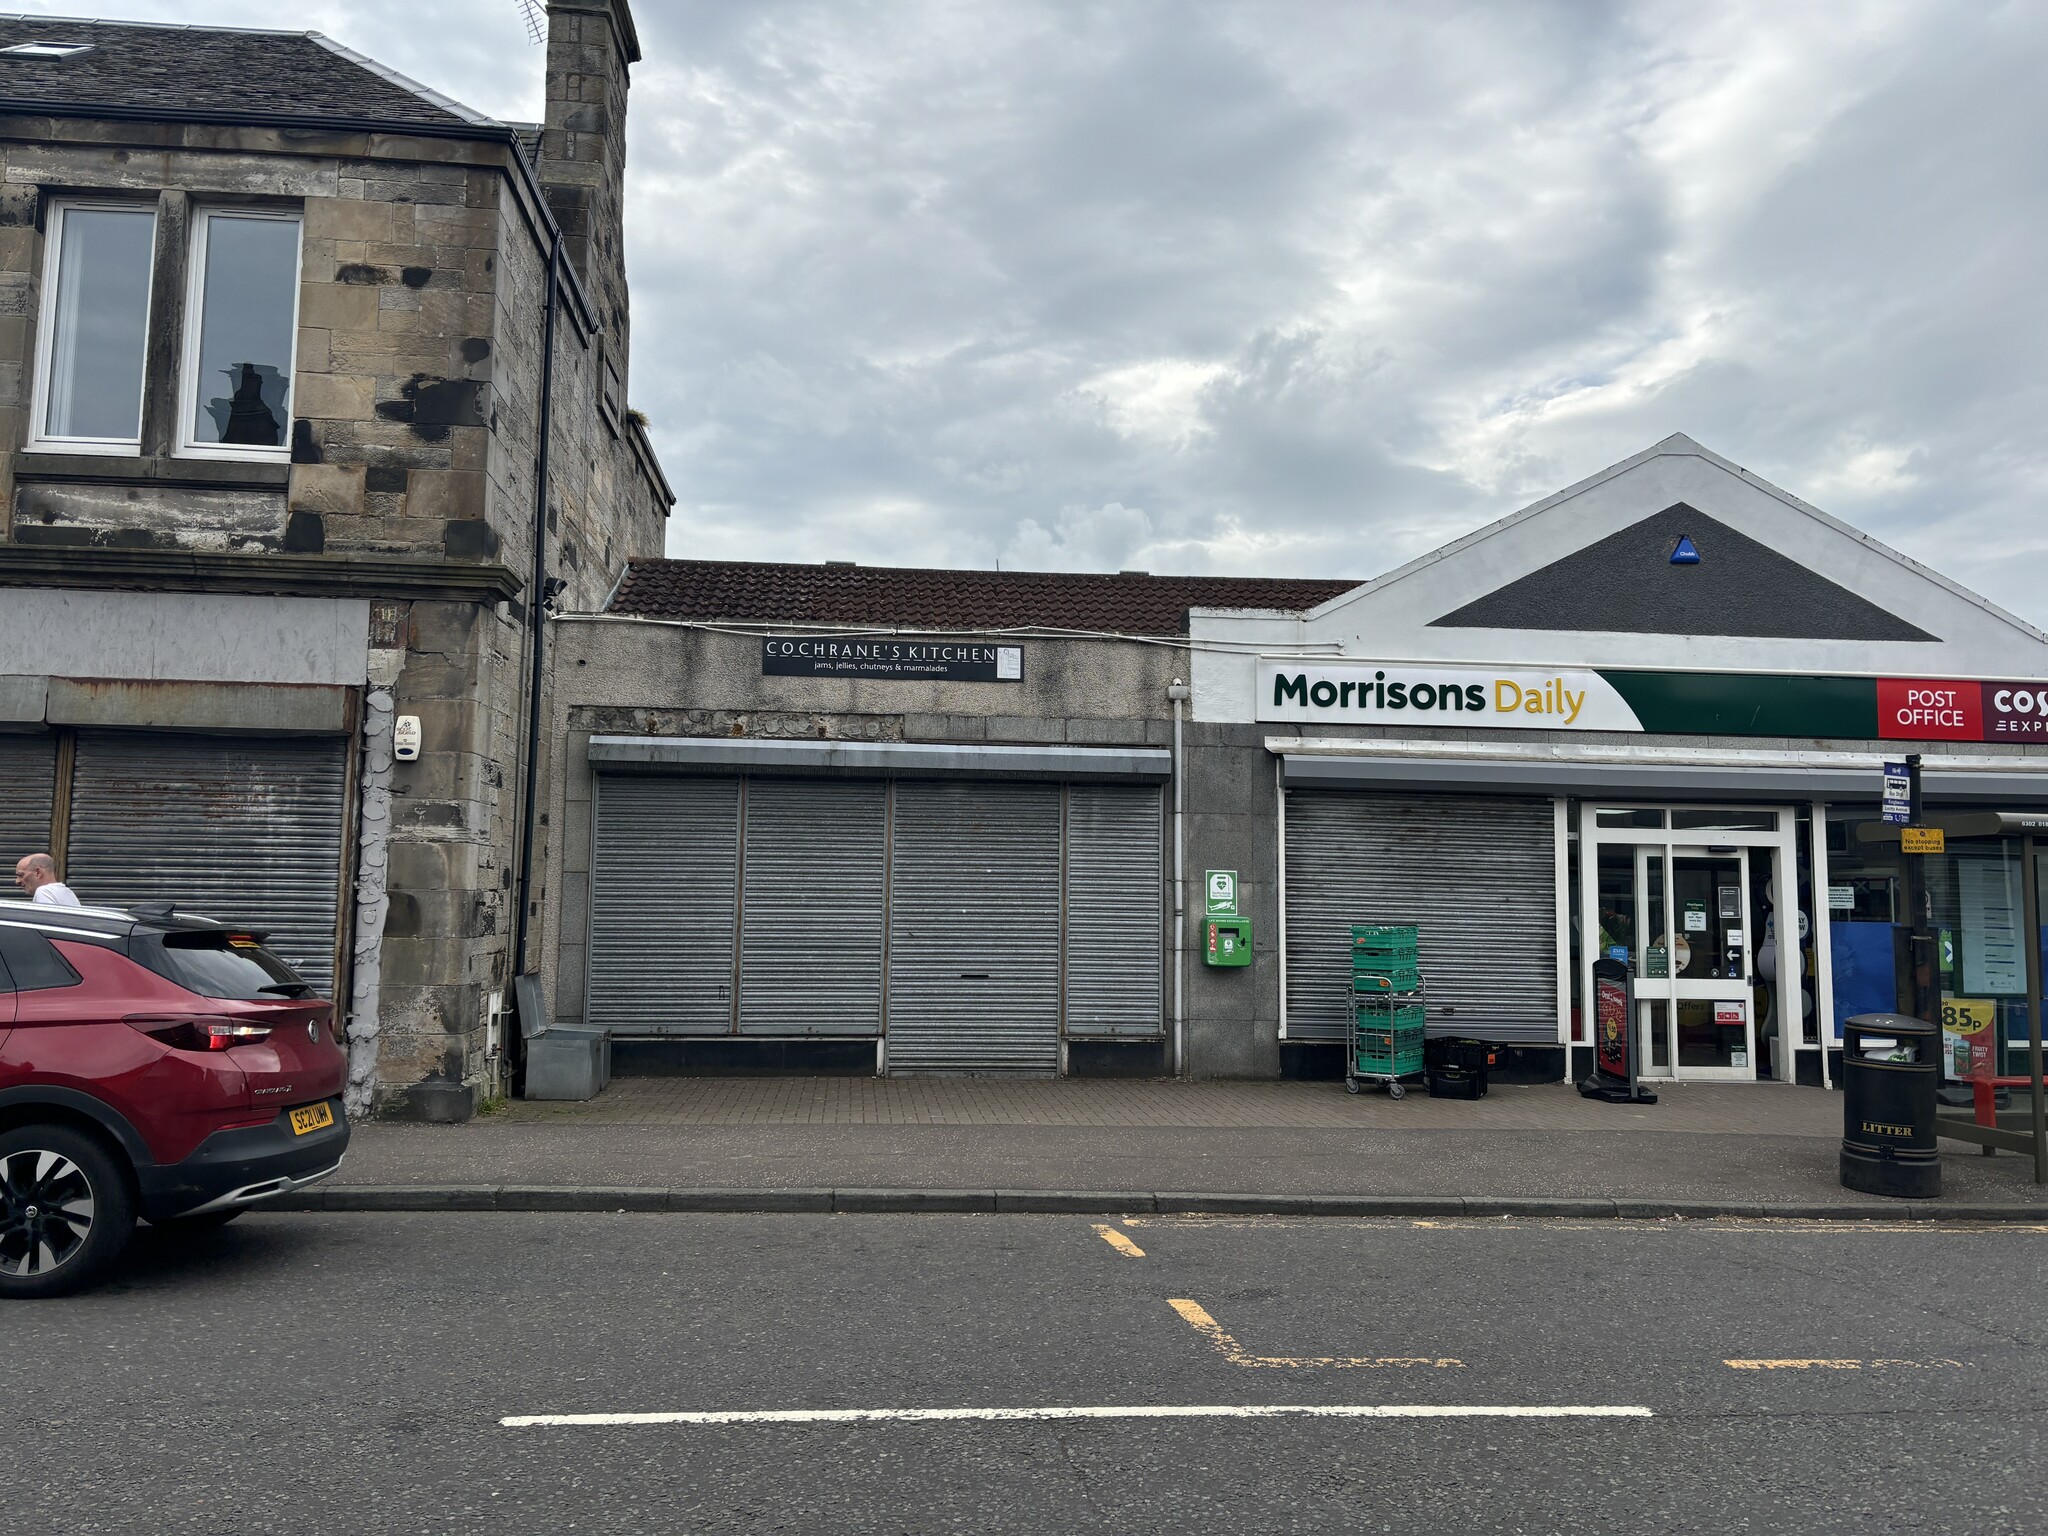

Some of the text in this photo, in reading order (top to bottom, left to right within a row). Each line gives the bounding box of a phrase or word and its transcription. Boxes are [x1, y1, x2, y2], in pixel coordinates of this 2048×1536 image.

[767, 641, 995, 661] COCHRANE'S KITCHEN
[814, 661, 948, 673] jams, jellies, chutneys & marmalades
[1274, 670, 1585, 725] Morrisons Daily
[1908, 689, 1957, 707] POST
[1897, 708, 1965, 727] OFFICE
[2009, 720, 2048, 732] EXP
[1677, 1001, 1704, 1010] Offers
[1862, 1121, 1913, 1137] LITTER
